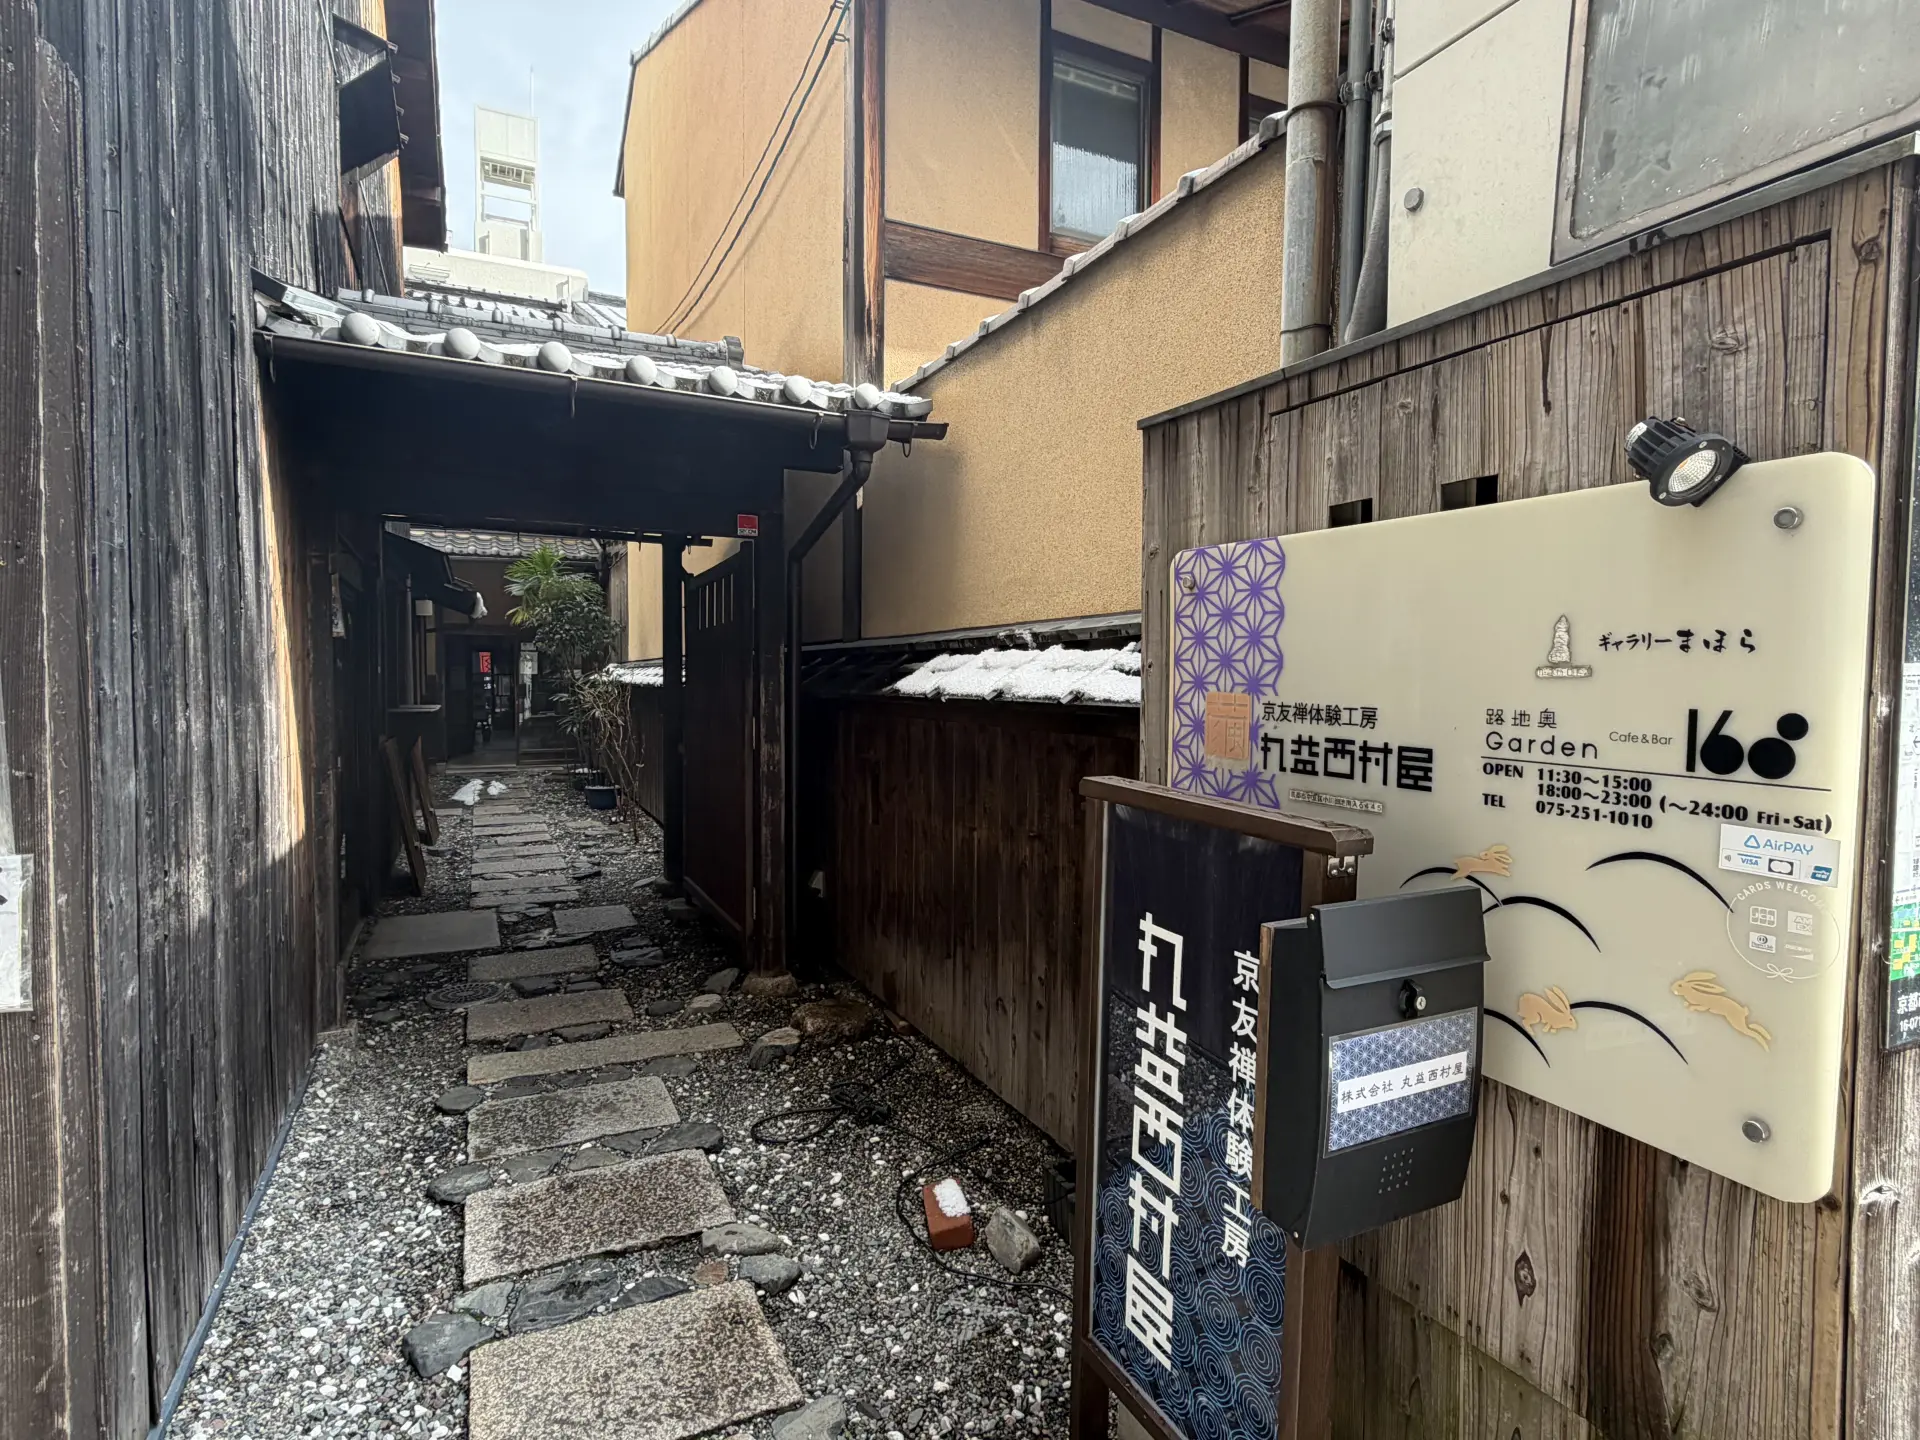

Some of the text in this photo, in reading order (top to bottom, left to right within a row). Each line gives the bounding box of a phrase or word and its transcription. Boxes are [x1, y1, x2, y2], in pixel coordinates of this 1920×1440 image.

[1599, 629, 1756, 653] ギャラリーまほら
[1261, 701, 1379, 730] 京友禅体験工房
[1485, 708, 1557, 729] 路地奥
[1485, 731, 1598, 759] Garden
[1260, 732, 1434, 792] 丸益西村屋
[1482, 762, 1524, 778] OPEN
[1482, 793, 1653, 829] TEL 075-251-1010
[1762, 838, 1814, 856] AirPAY
[1740, 857, 1759, 866] VISA
[1736, 881, 1828, 911] CARDS WELCOM
[1896, 990, 1920, 1015] 京都
[1341, 1061, 1464, 1104] 株式会社 丸益西村屋
[1221, 949, 1261, 1269] 京友禅体験工房
[1124, 911, 1188, 1373] 丸益西村屋
